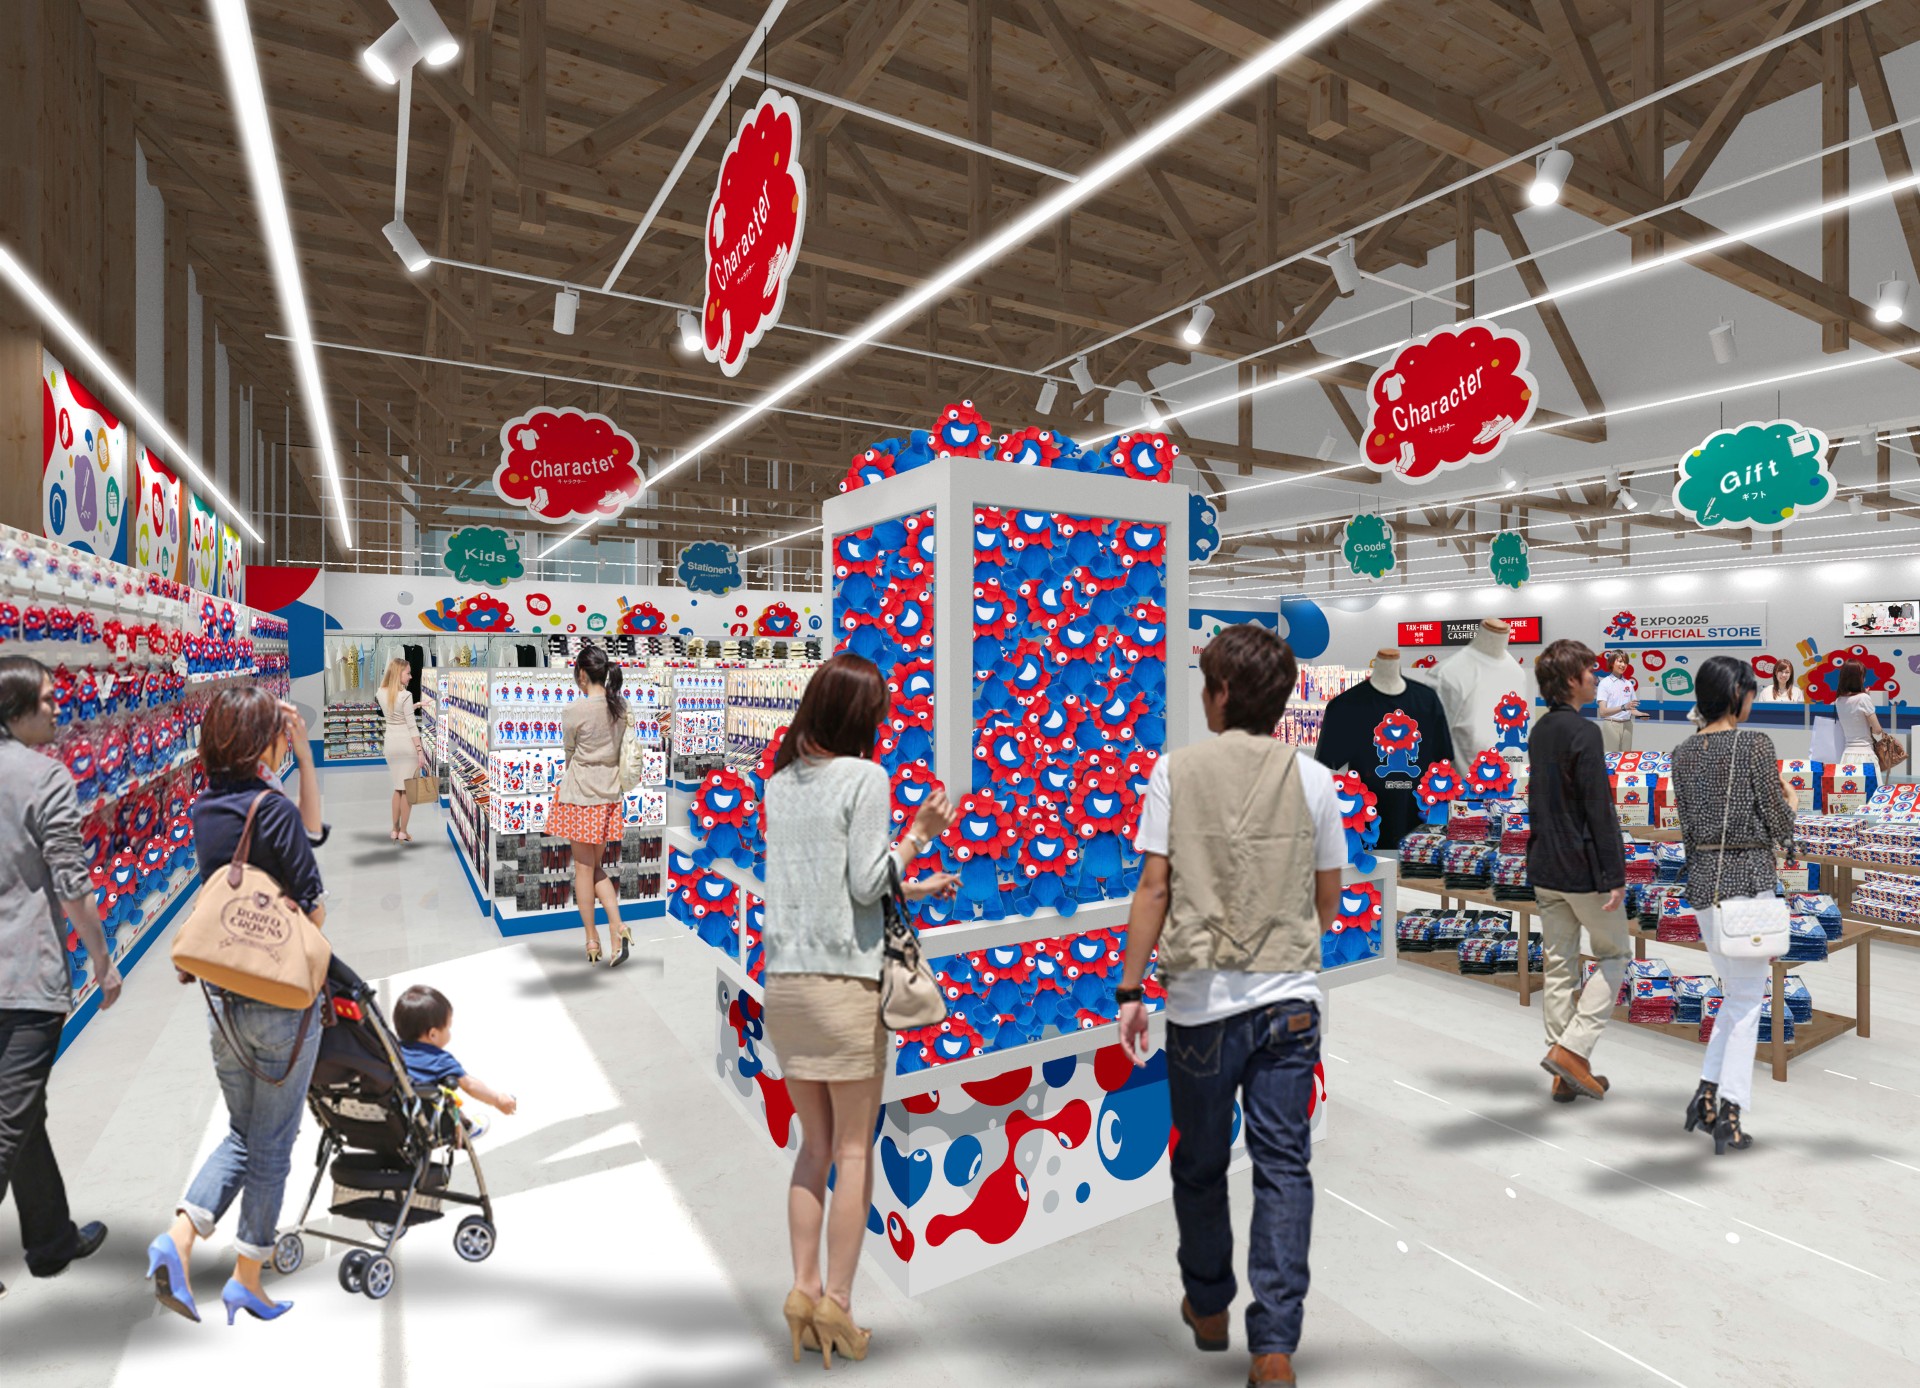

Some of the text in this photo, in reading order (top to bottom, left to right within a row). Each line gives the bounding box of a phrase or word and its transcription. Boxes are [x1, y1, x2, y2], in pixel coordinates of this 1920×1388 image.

[714, 178, 771, 291] Character
[737, 262, 756, 285] キャラクター
[1392, 365, 1483, 431] Character
[1428, 423, 1456, 434] キャラクター
[530, 454, 615, 479] Character
[1719, 459, 1779, 494] Gift
[1742, 490, 1767, 501] ギフト
[1353, 541, 1387, 553] Goods
[464, 547, 507, 563] Kids
[1498, 556, 1520, 566] Gift
[687, 561, 733, 575] Stationery
[1405, 623, 1434, 631] TAX-FREE
[1446, 623, 1480, 631] TAX-FREE
[1640, 615, 1709, 627] EXPO2025
[1640, 626, 1761, 640] OFFICIAL STORE
